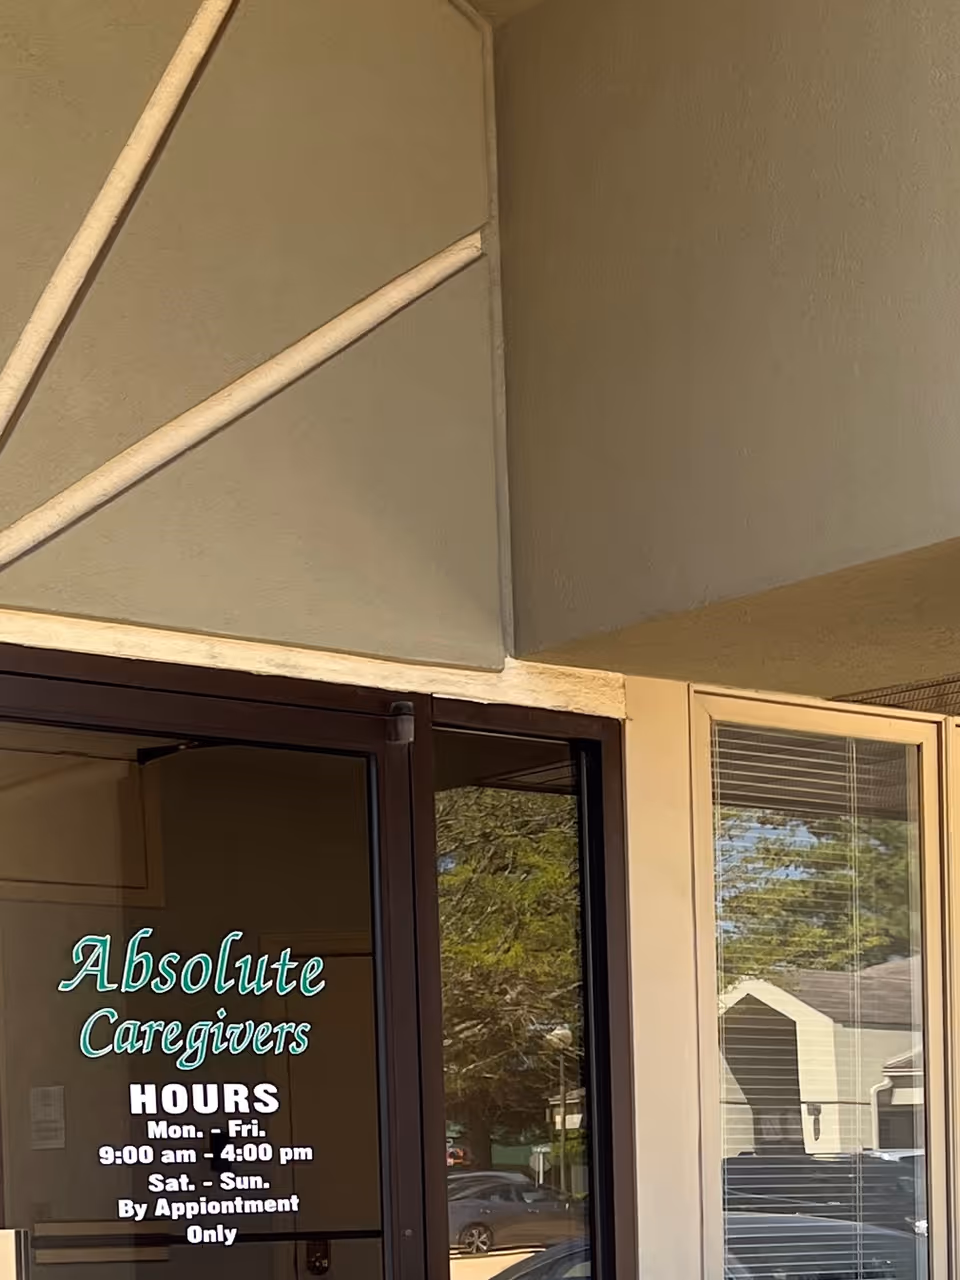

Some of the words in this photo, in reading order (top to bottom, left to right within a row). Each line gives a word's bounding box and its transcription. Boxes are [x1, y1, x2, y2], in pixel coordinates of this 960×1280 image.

[58, 927, 326, 997] Absolute
[79, 1007, 312, 1071] Caregivers
[129, 1083, 279, 1115] HOURS
[147, 1120, 204, 1139] Mon.
[228, 1119, 266, 1138] Fri.
[98, 1145, 154, 1165] 9:00
[161, 1149, 197, 1164] am
[220, 1143, 273, 1162] 4:00
[279, 1147, 313, 1165] pm
[148, 1173, 196, 1192] Sat.
[220, 1171, 270, 1190] Sun.
[118, 1199, 148, 1221] By
[154, 1194, 300, 1220] Appiontment
[186, 1224, 237, 1246] Only
